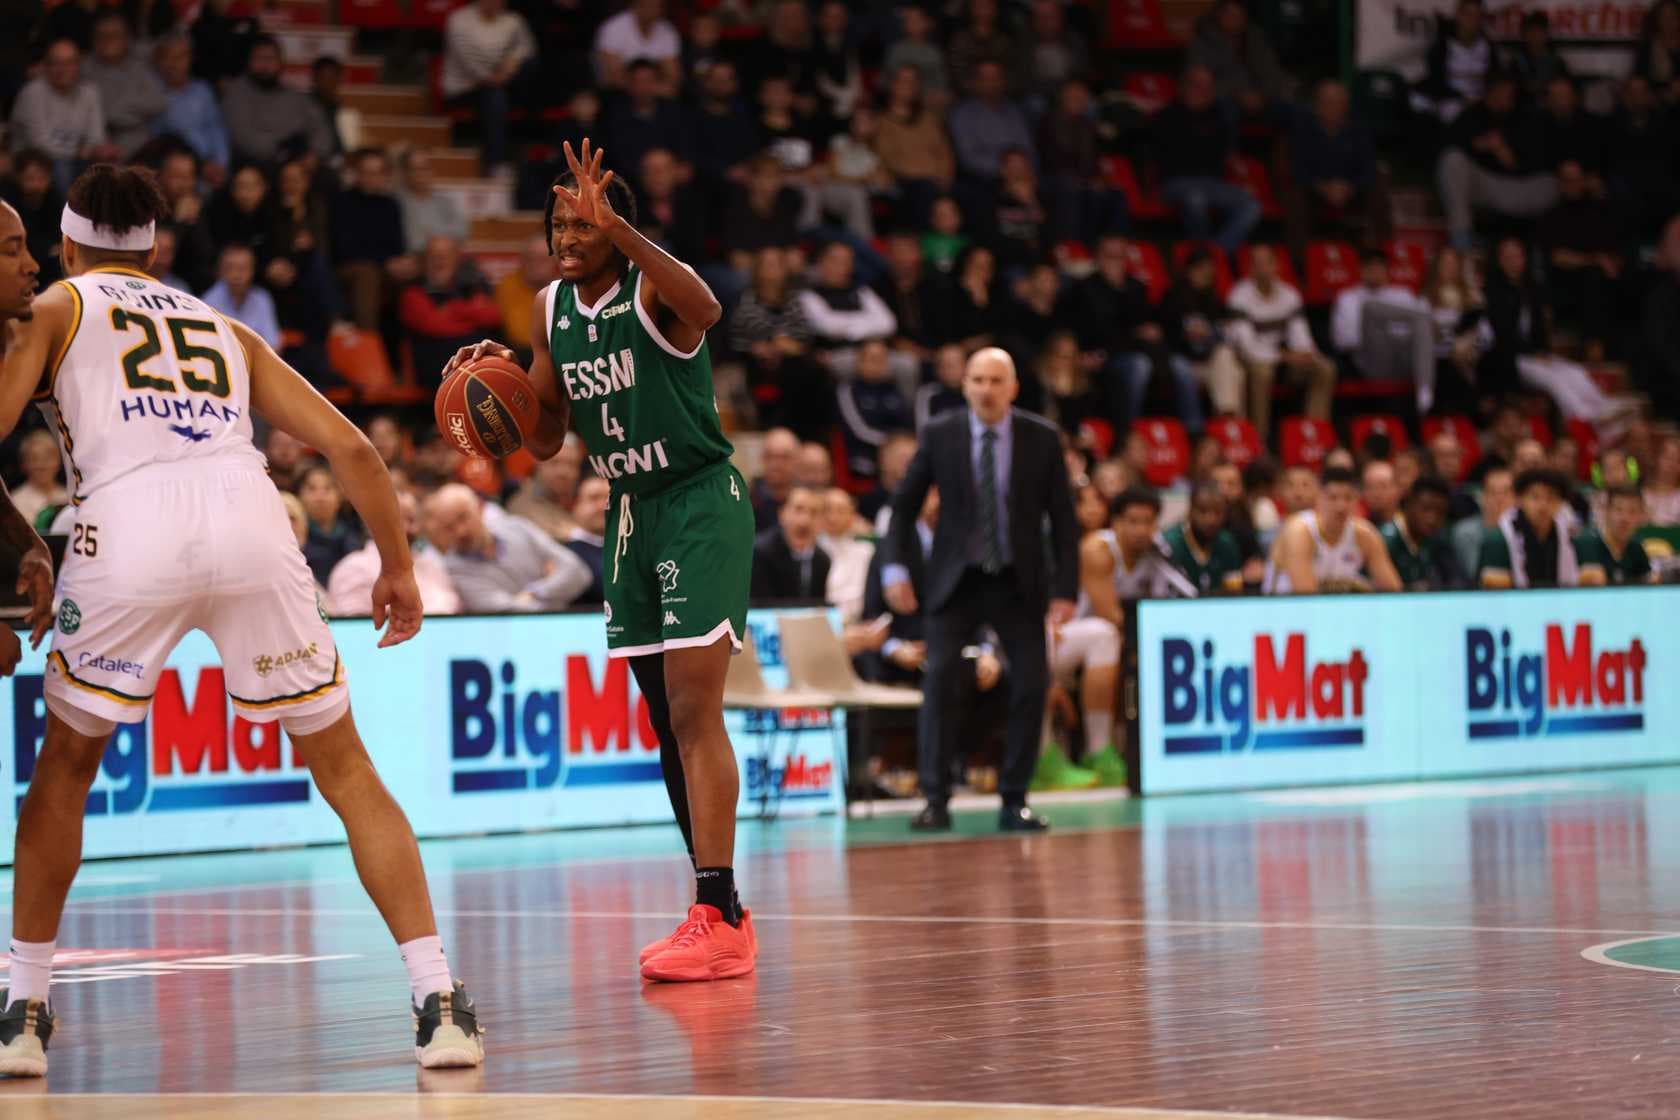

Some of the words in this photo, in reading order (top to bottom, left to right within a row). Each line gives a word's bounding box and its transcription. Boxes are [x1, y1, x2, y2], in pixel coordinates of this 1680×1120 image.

[110, 306, 232, 398] 25
[121, 395, 240, 422] HUMAN
[601, 402, 625, 442] 4
[729, 475, 741, 501] 4
[73, 523, 98, 557] 25
[1162, 633, 1368, 752] BigMat
[1466, 621, 1647, 737] BigMat
[449, 653, 661, 791] BigM
